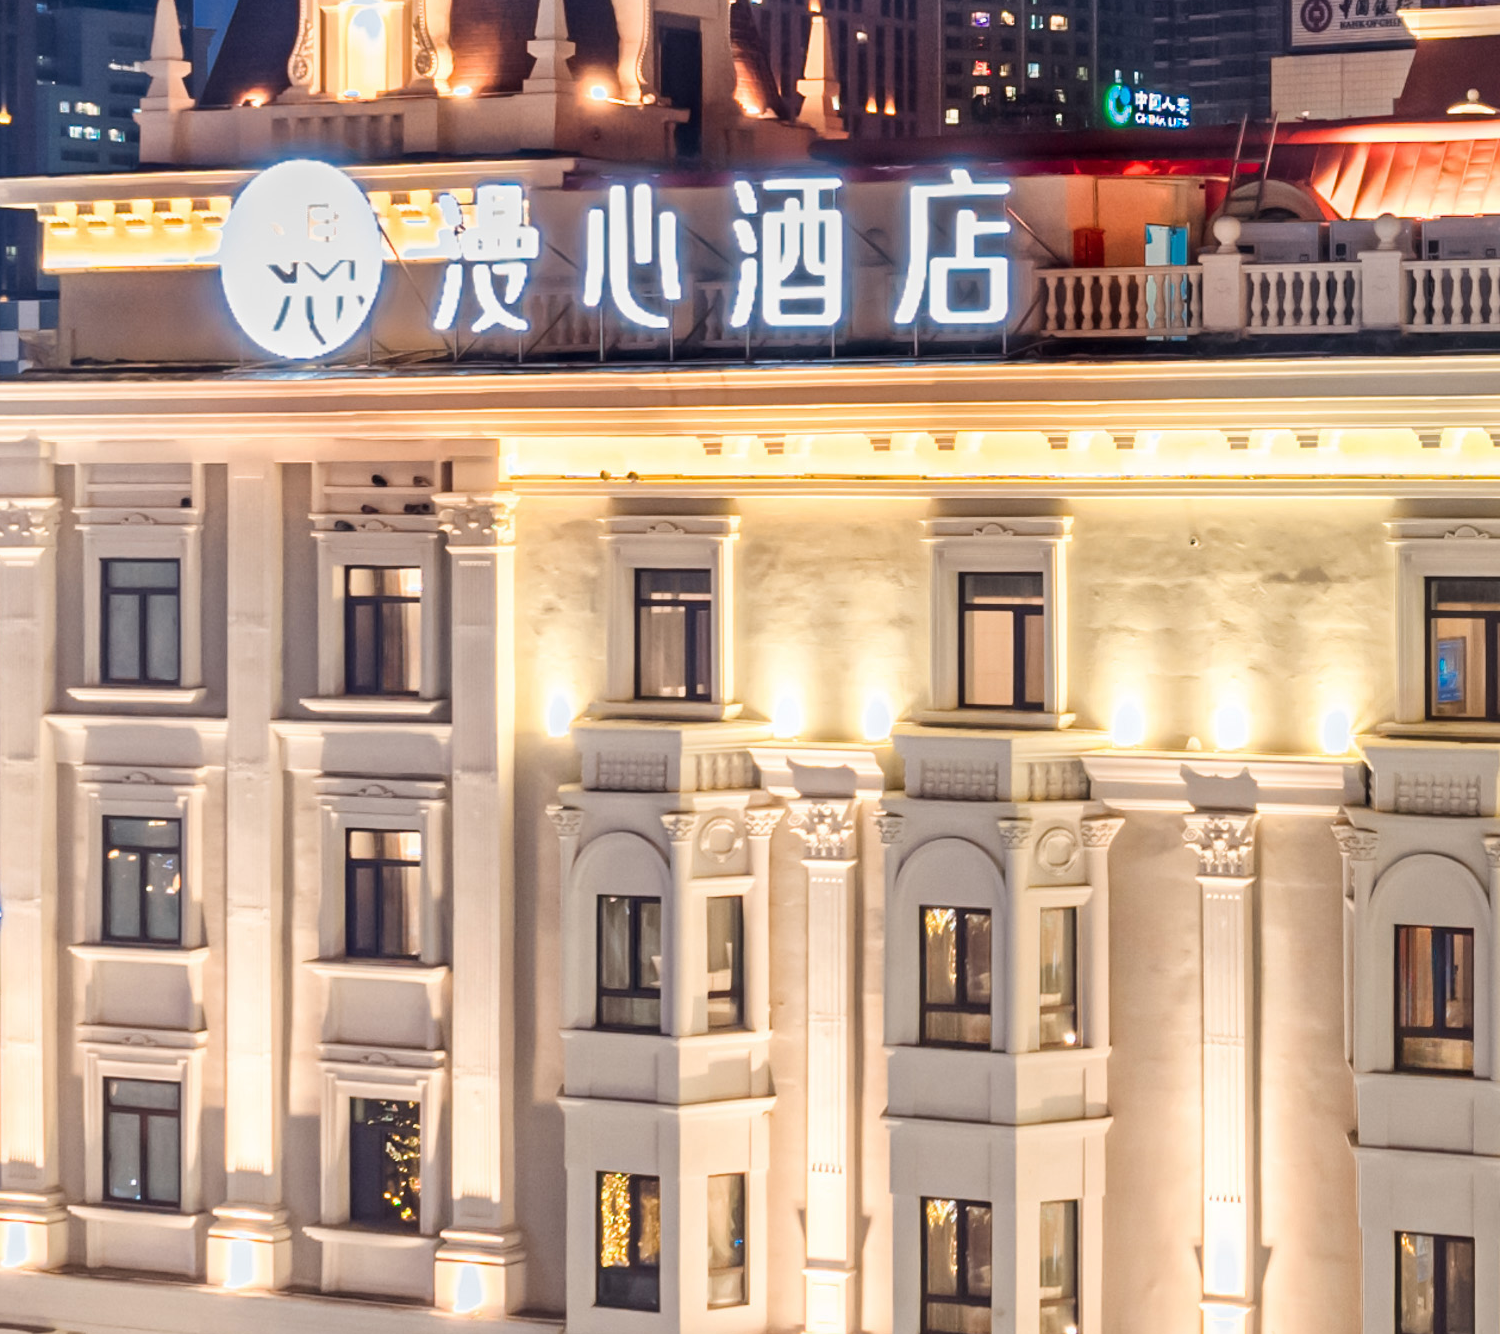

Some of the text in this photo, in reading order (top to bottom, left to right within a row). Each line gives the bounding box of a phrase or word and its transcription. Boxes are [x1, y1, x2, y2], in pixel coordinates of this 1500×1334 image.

[1135, 90, 1189, 116] 中国人寿
[1135, 112, 1166, 127] CHINA
[433, 169, 1012, 333] 漫心酒店
